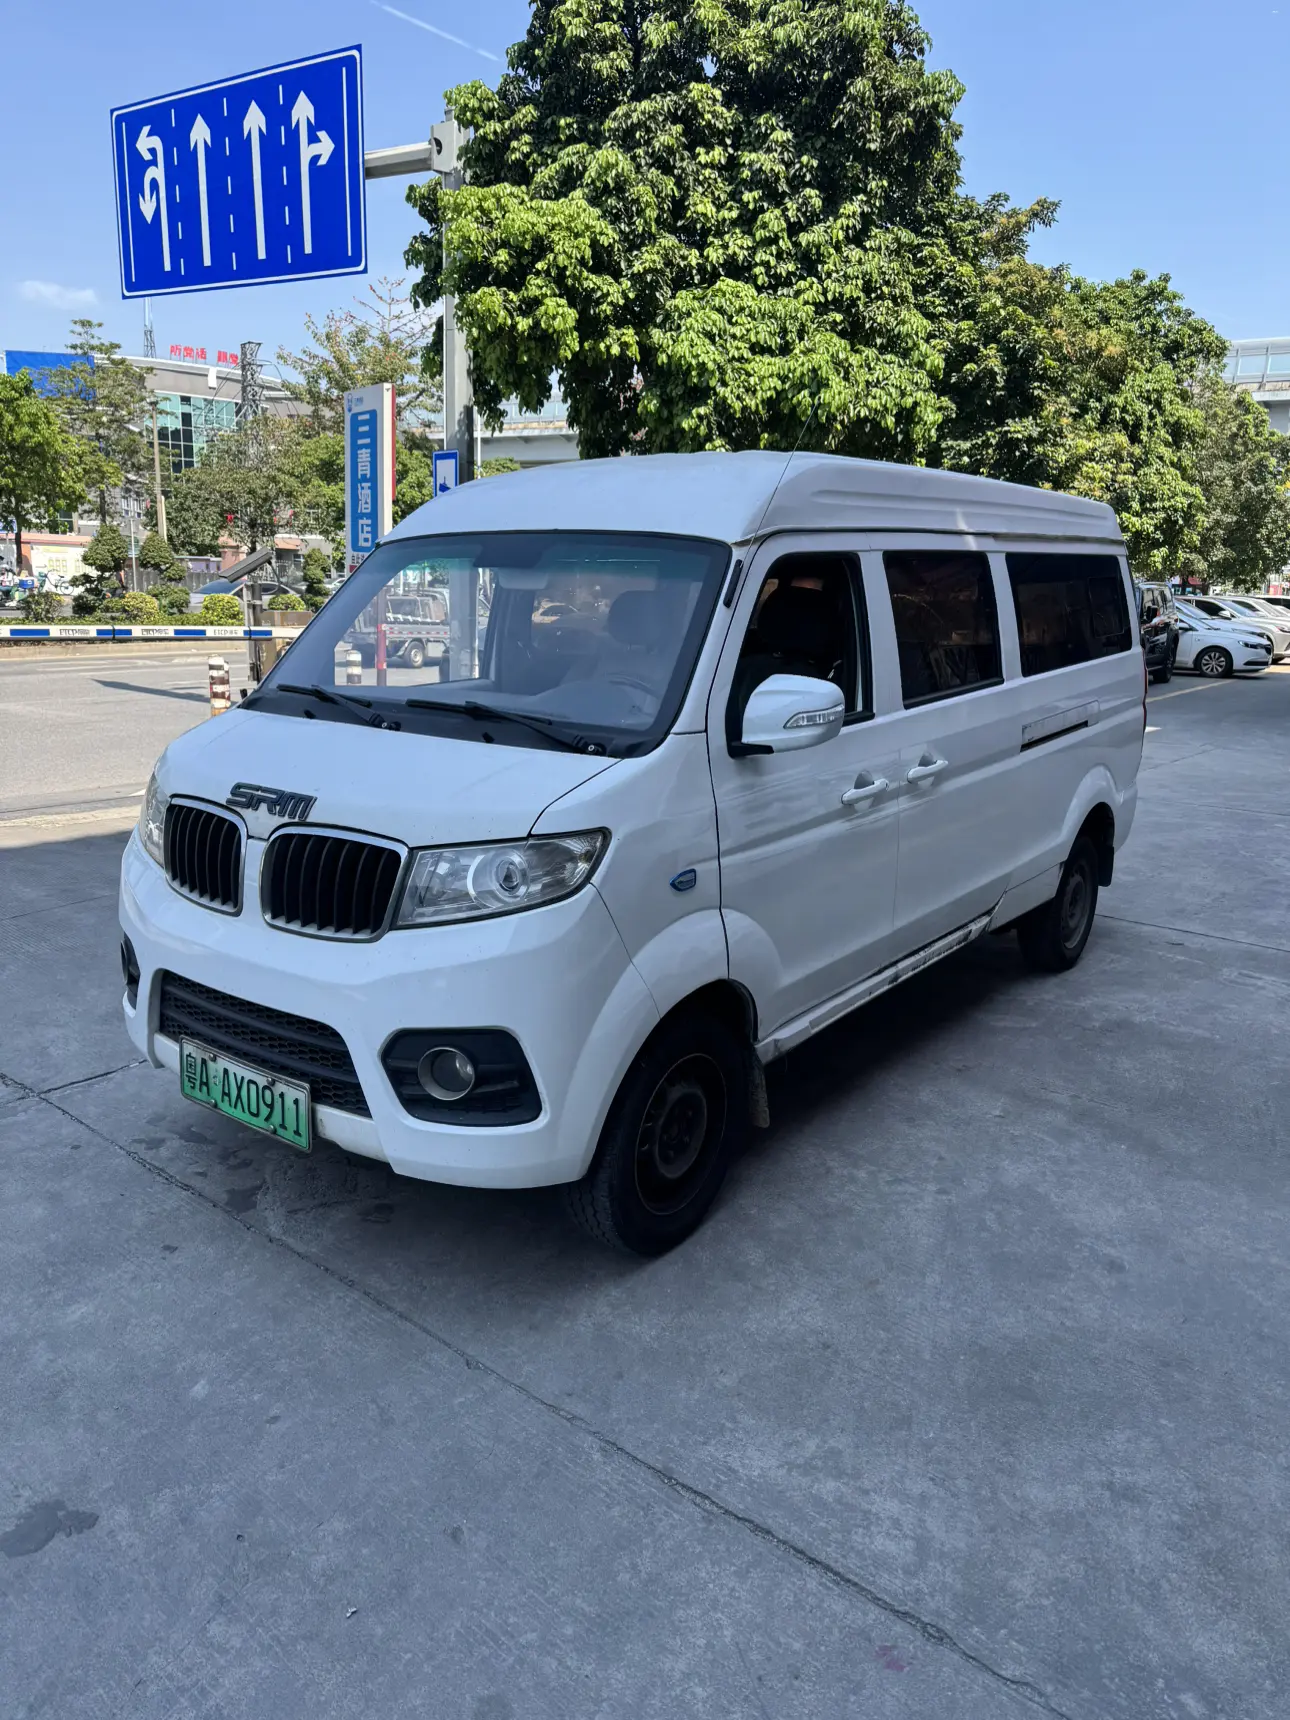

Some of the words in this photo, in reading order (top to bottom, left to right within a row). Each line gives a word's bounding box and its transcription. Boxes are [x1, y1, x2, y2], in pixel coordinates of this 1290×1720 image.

[357, 413, 371, 548] 三青酒店
[225, 782, 318, 821] SRM
